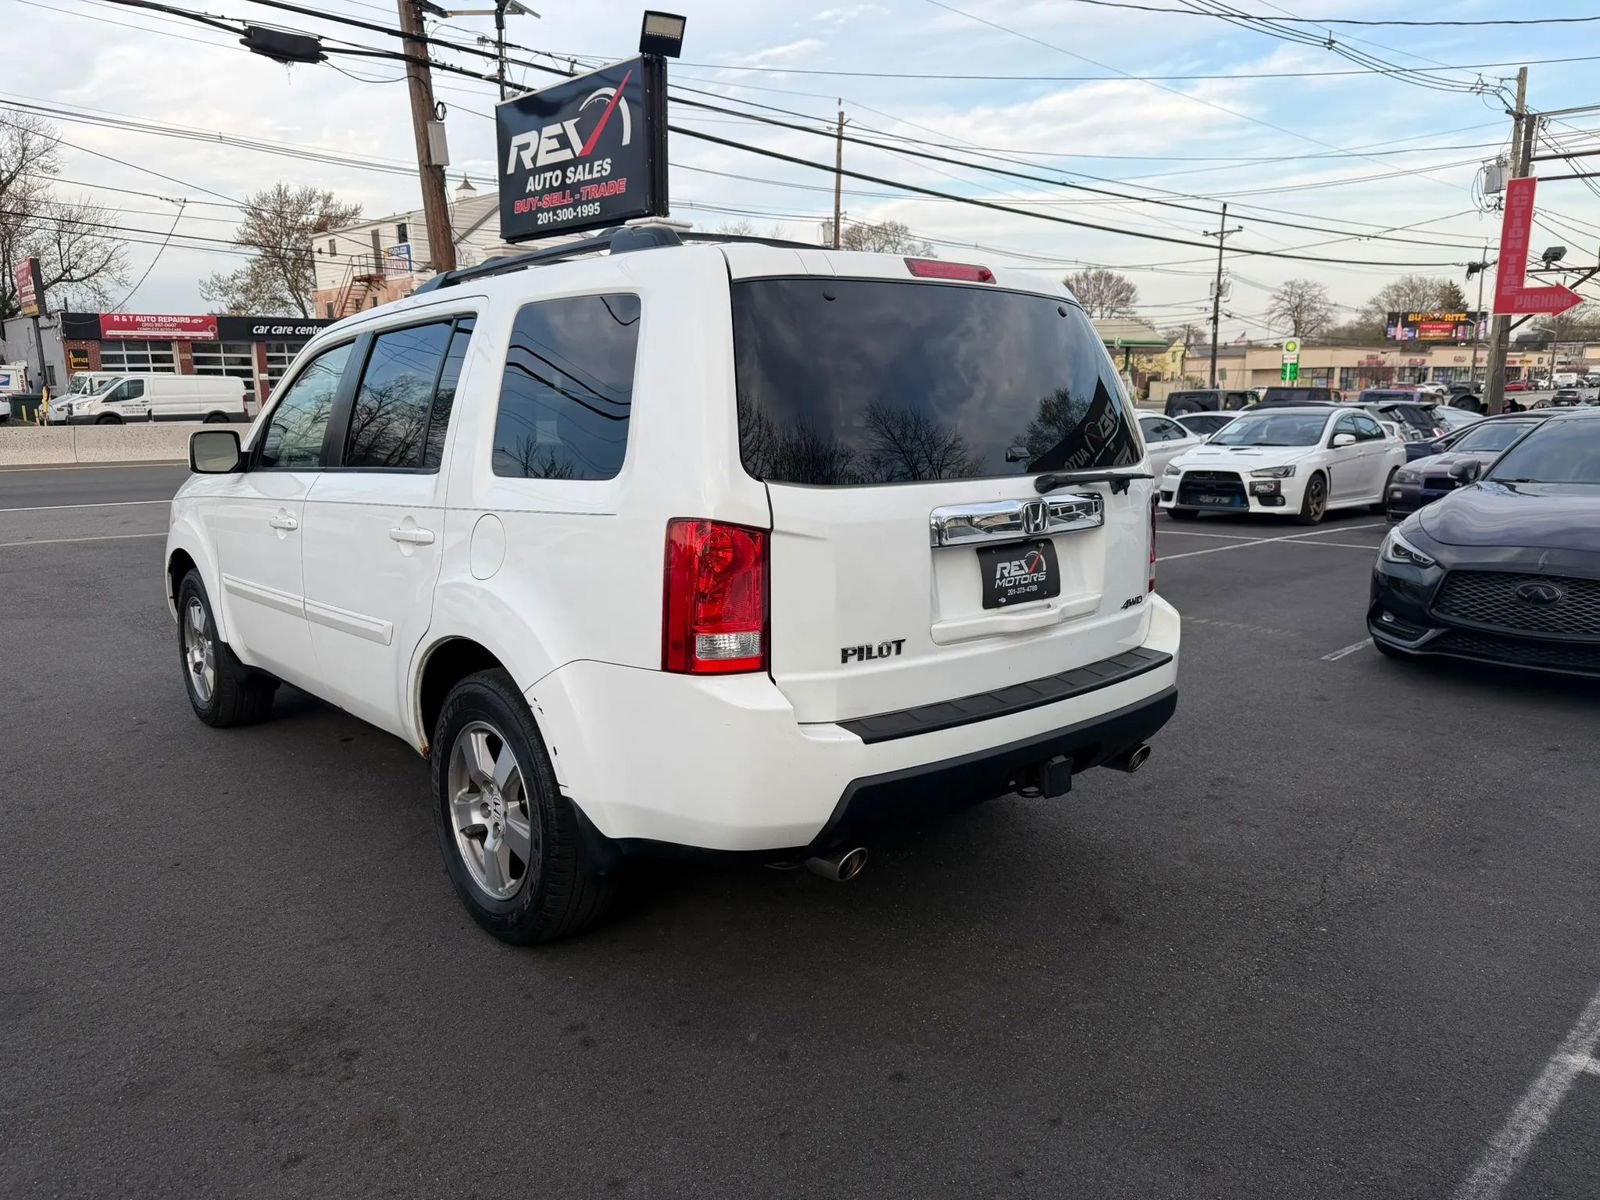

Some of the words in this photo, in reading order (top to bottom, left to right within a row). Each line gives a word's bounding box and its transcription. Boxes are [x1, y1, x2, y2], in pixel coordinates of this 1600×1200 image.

[525, 169, 562, 193] AUTO
[566, 158, 612, 184] SALES
[537, 202, 601, 225] 201-300-1995
[1513, 294, 1570, 309] PARKING
[158, 316, 190, 324] REPAIRS
[252, 325, 270, 334] car
[271, 325, 294, 335] care
[295, 325, 326, 335] cente
[995, 553, 1042, 579] REV
[994, 571, 1047, 589] MOTORS
[840, 638, 906, 664] PILOT
